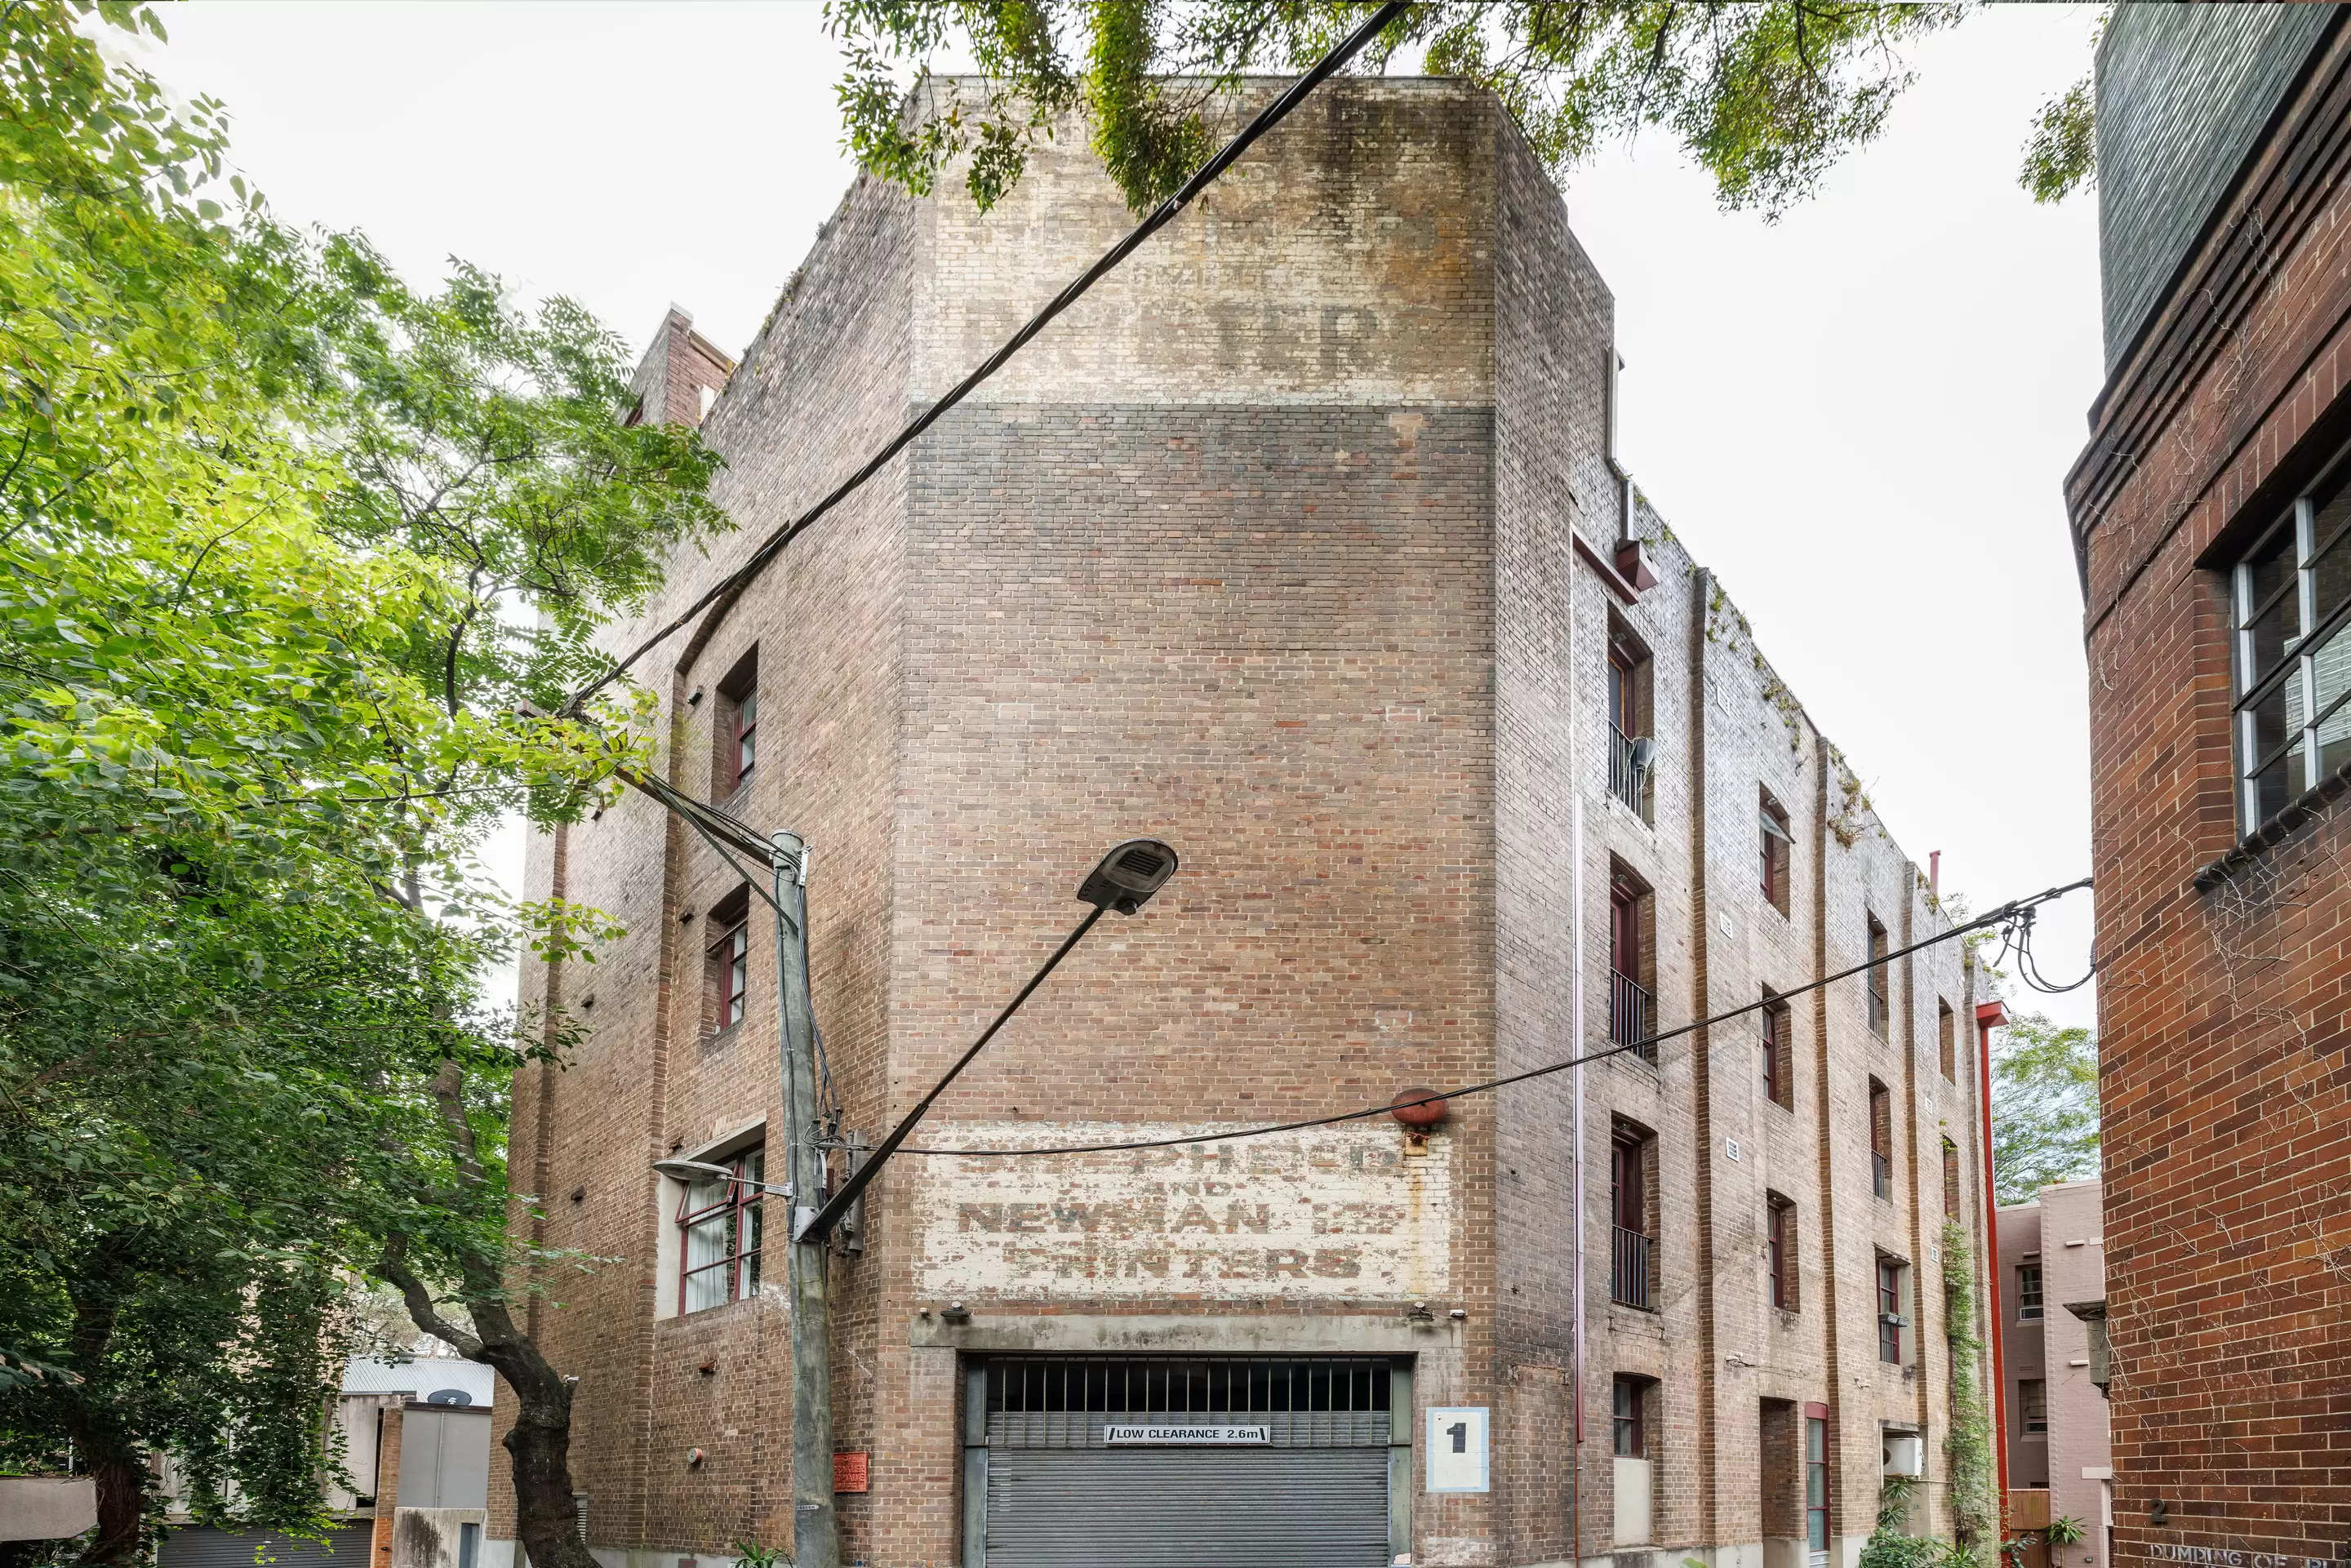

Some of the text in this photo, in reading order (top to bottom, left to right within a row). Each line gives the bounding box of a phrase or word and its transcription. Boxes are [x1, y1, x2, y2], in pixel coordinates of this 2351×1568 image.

[1117, 1429, 1258, 1438] LOW CLEARANCE 2.6m
[1447, 1423, 1466, 1453] 1
[833, 1465, 864, 1473] PRINKLER
[2149, 1499, 2167, 1522] 2
[2149, 1544, 2242, 1566] DUMPING
